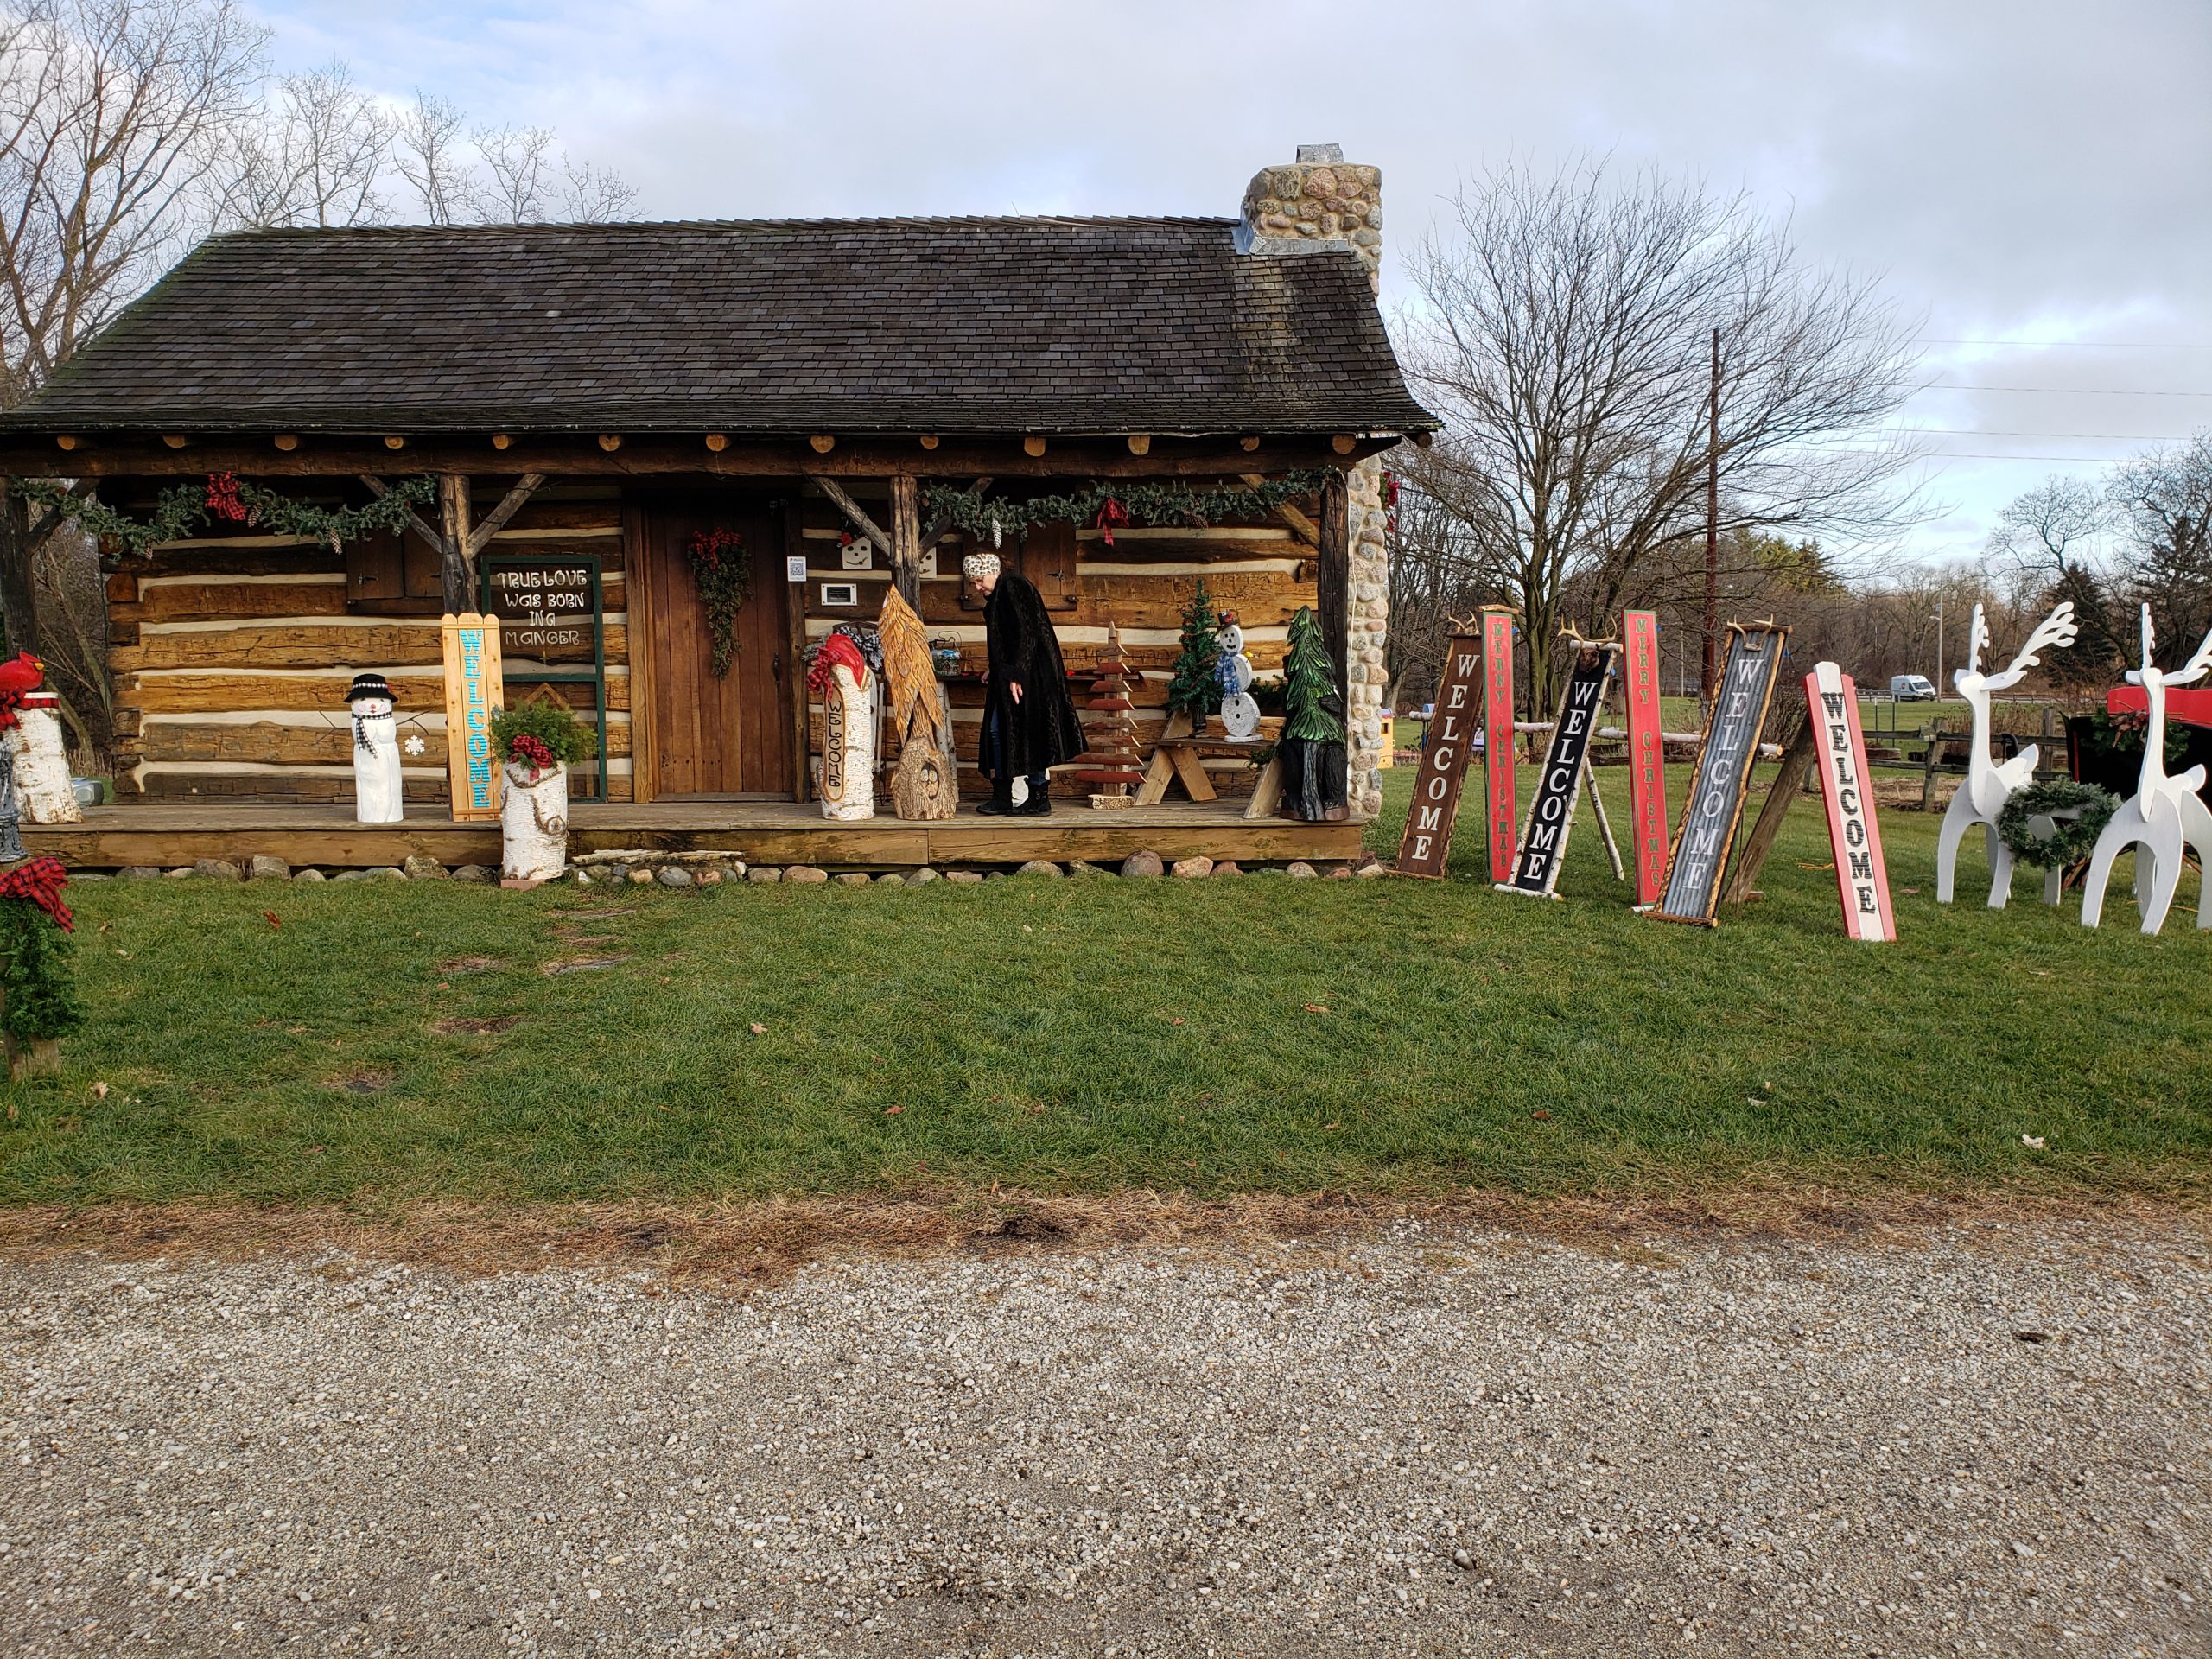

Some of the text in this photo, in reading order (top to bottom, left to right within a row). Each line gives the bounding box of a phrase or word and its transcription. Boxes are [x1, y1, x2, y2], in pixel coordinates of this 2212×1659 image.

[496, 569, 587, 588] TRUE LOVE
[529, 610, 543, 626] IN
[548, 592, 584, 608] BORN
[1492, 623, 1504, 704] MERRY
[1636, 619, 1650, 705] MERRY
[458, 629, 491, 808] WELCOME
[828, 701, 842, 788] WELCOME
[1411, 654, 1480, 861] WELCOME
[1524, 682, 1598, 880] WELCOME
[1682, 658, 1764, 890] WELCOME
[1821, 691, 1876, 914] WELCOME
